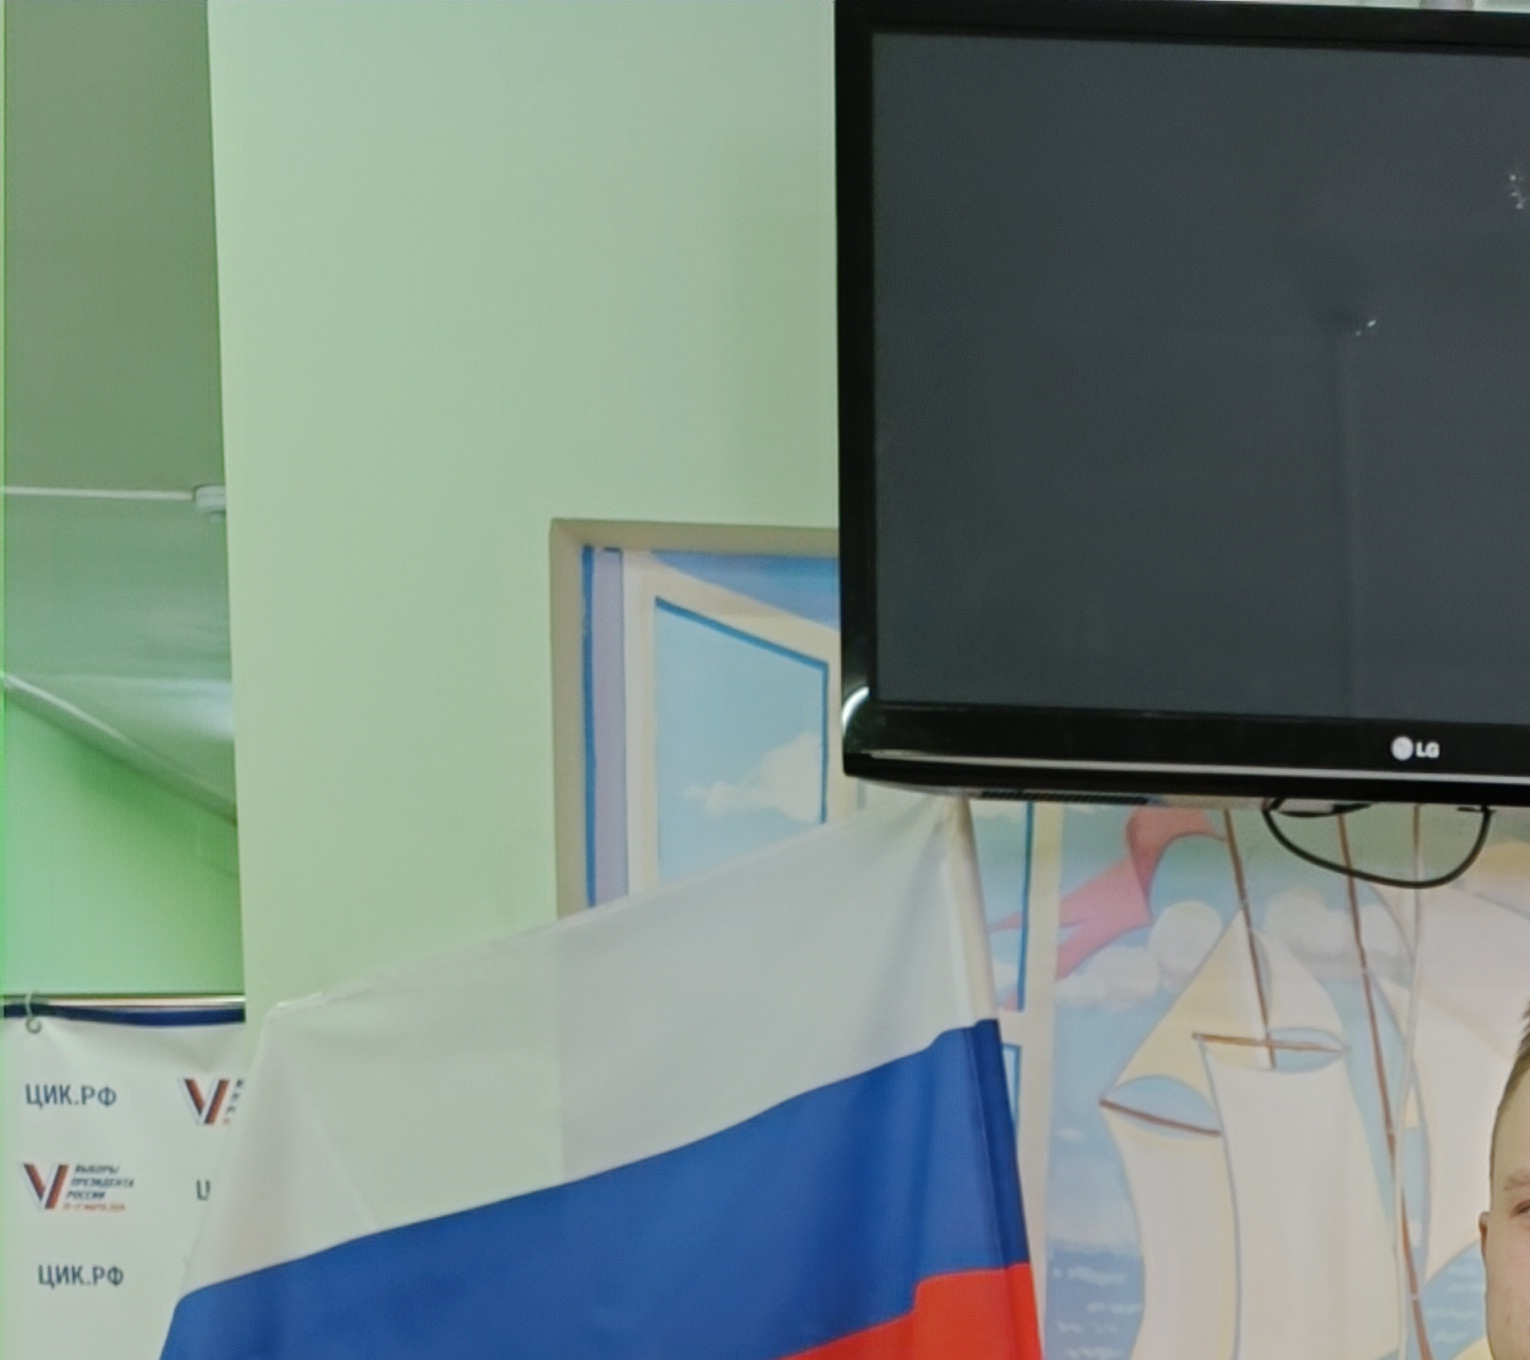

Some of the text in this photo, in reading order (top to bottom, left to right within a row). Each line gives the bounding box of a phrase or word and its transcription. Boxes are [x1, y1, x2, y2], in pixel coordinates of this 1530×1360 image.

[1416, 741, 1440, 758] LG
[25, 1084, 117, 1109] ЦИК.РФ
[38, 1265, 124, 1289] ЦИК.РФ
